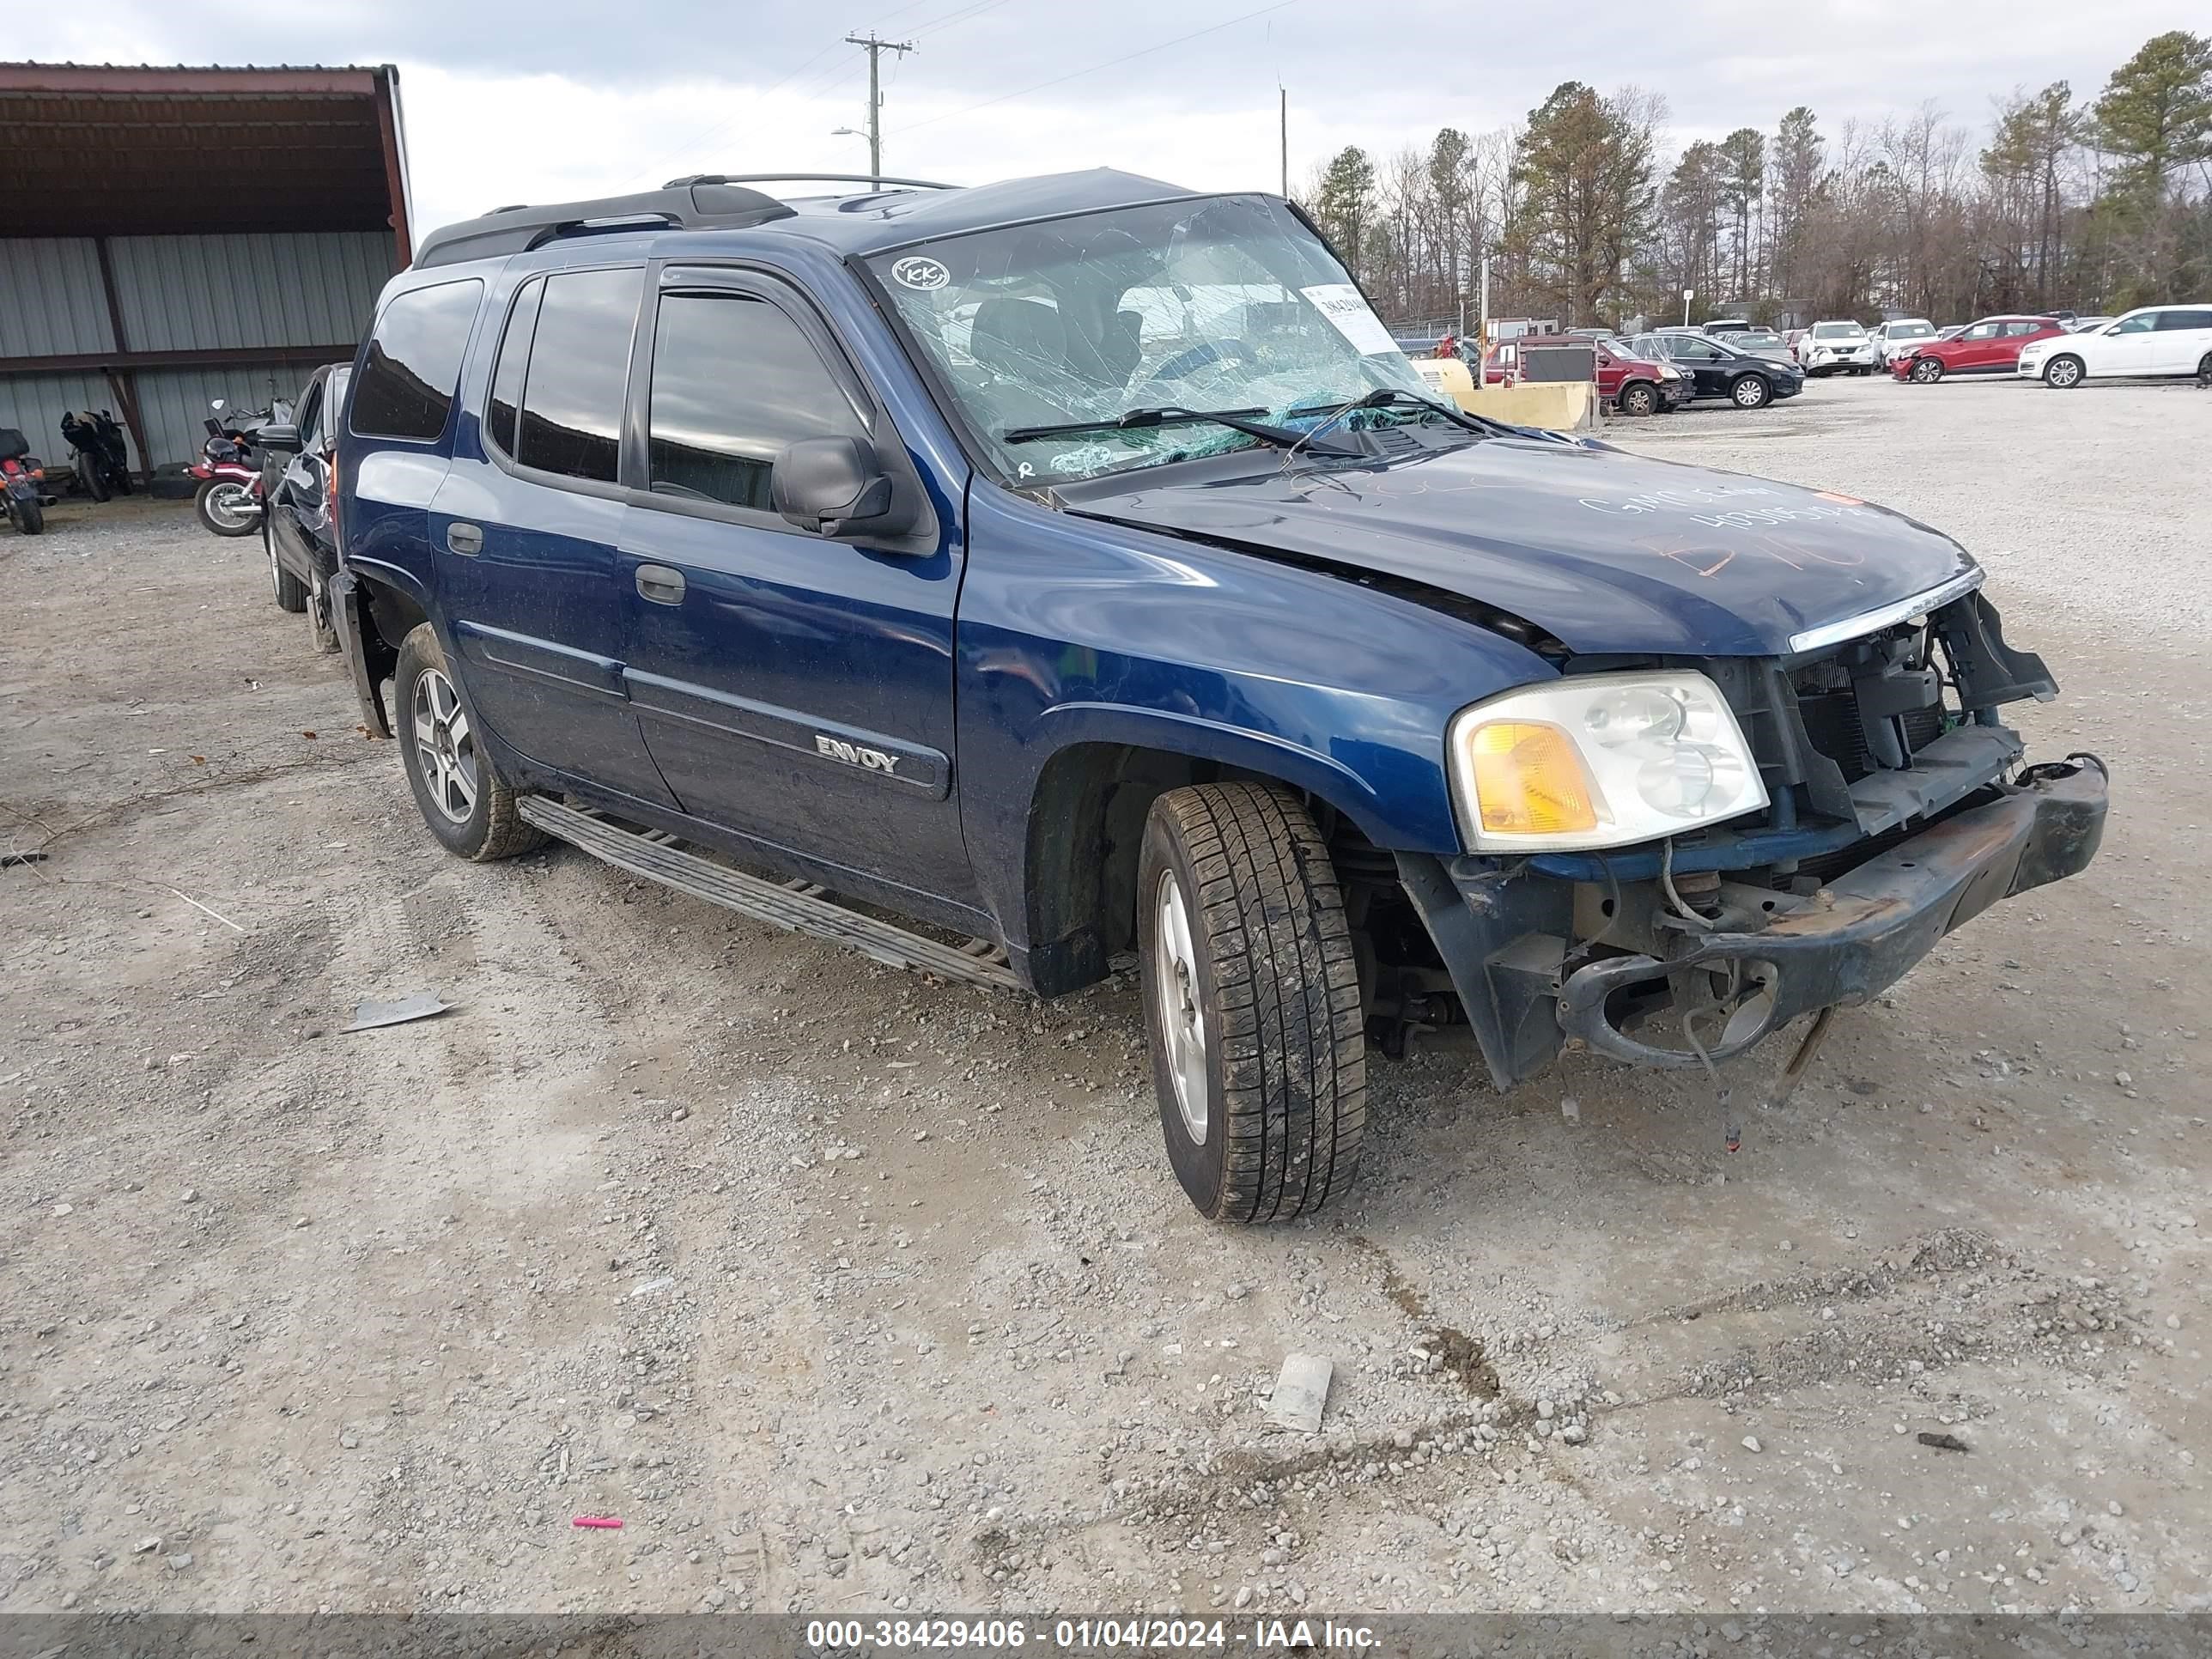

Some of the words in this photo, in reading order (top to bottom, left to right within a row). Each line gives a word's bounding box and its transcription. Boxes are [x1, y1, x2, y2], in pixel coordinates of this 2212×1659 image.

[907, 265, 939, 283] KK
[1018, 461, 1036, 479] R
[1578, 489, 1705, 515] GMC
[814, 734, 900, 774] ENVOY
